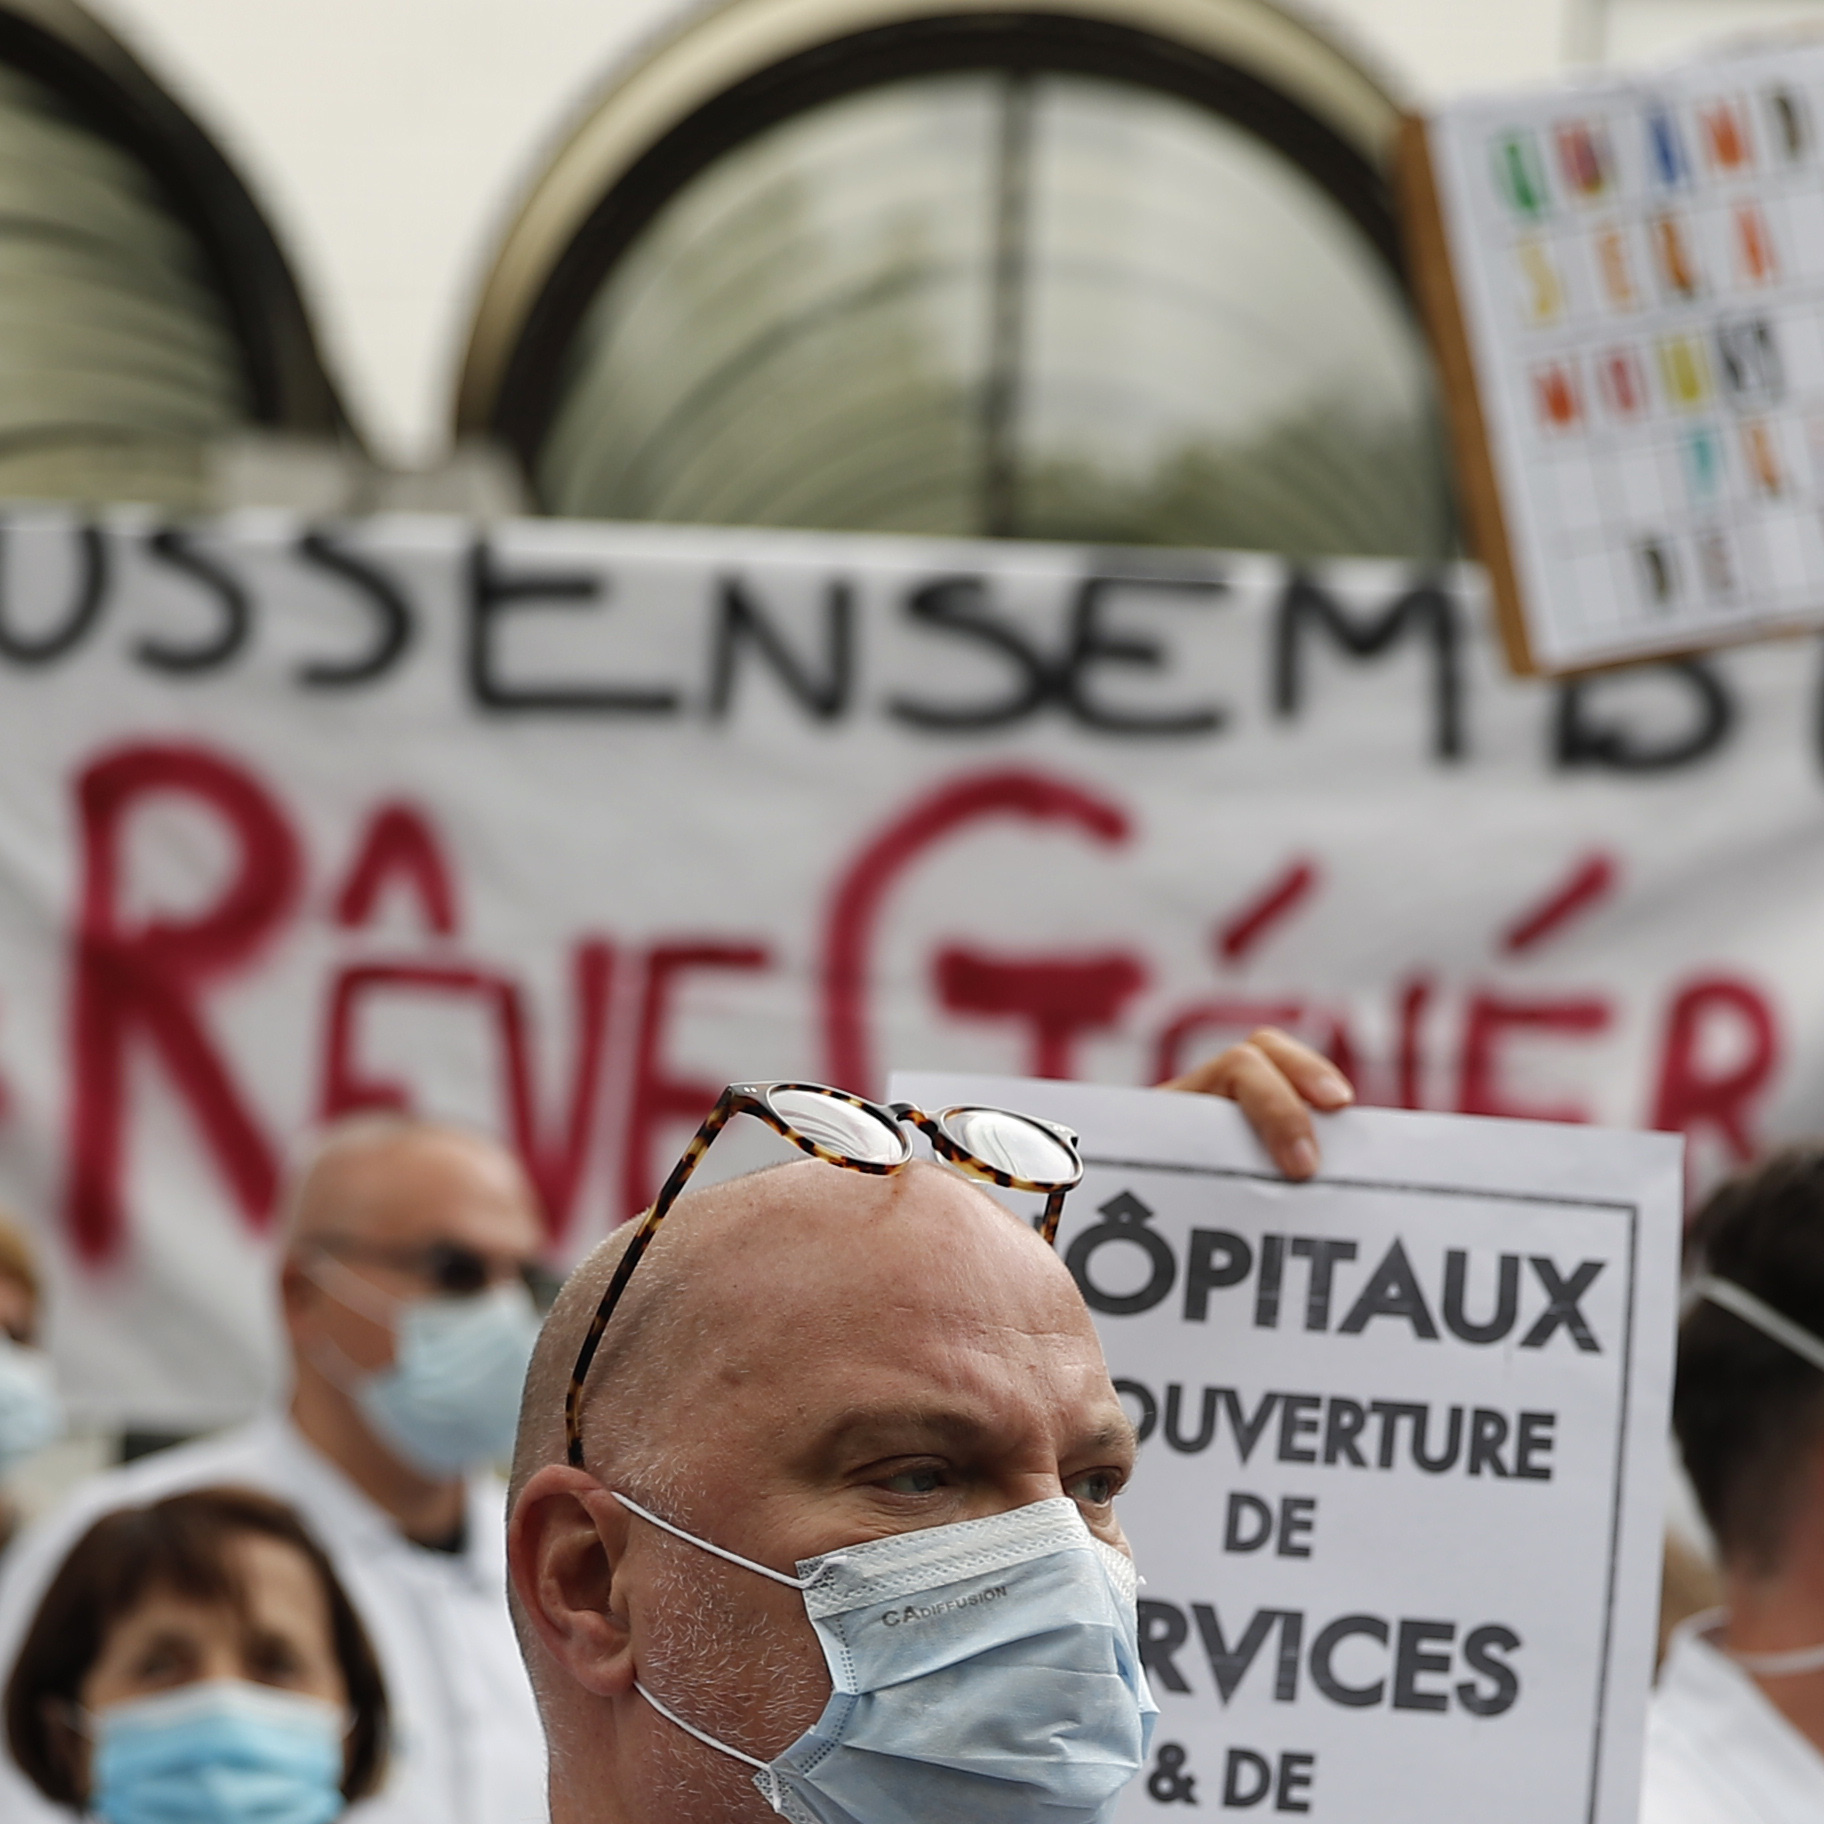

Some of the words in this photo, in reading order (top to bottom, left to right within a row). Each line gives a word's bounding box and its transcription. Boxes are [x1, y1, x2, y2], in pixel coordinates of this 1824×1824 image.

[1033, 1189, 1607, 1354] ÔPITAUX
[1110, 1377, 1556, 1482] OUVERTURE
[1222, 1491, 1316, 1559] DE
[1136, 1597, 1522, 1718] RVICES
[1147, 1743, 1197, 1806] &
[1223, 1748, 1315, 1813] DE
